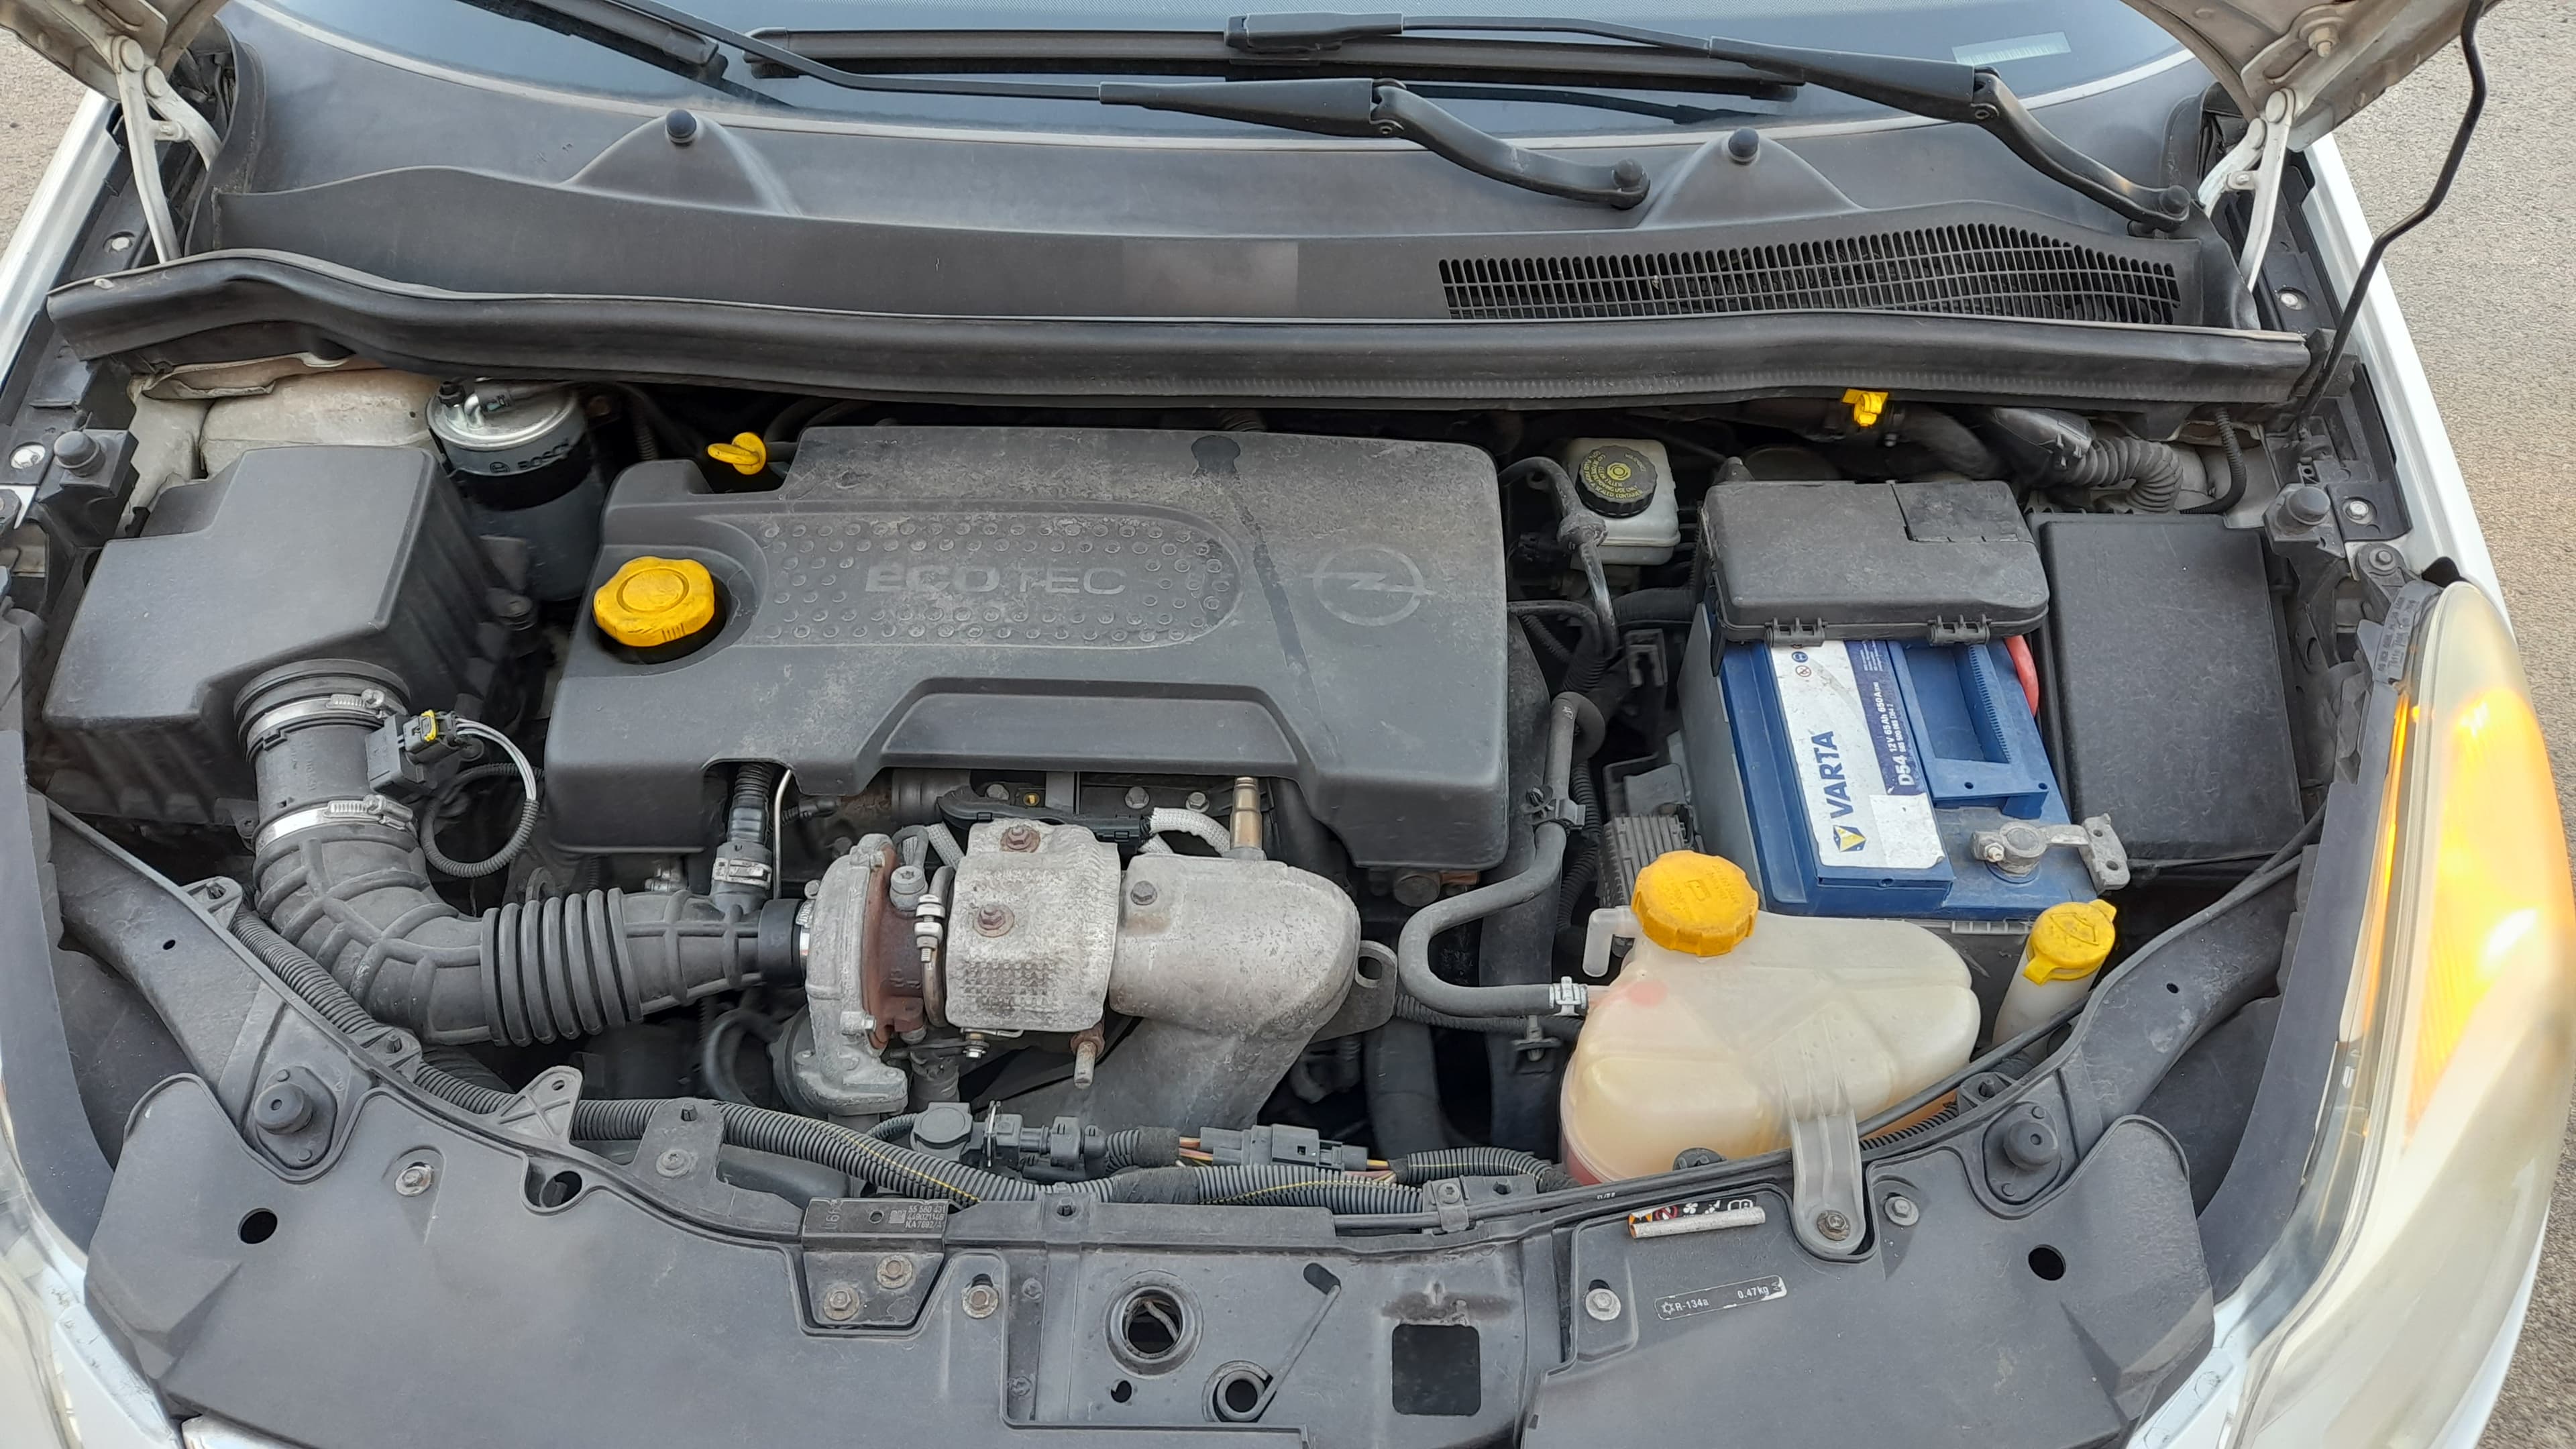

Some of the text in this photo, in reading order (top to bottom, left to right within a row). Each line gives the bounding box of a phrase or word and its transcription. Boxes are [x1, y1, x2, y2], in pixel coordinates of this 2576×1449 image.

[1811, 731, 1854, 819] VARTA
[1892, 755, 1915, 786] D54
[1674, 1298, 1709, 1311] R-134a
